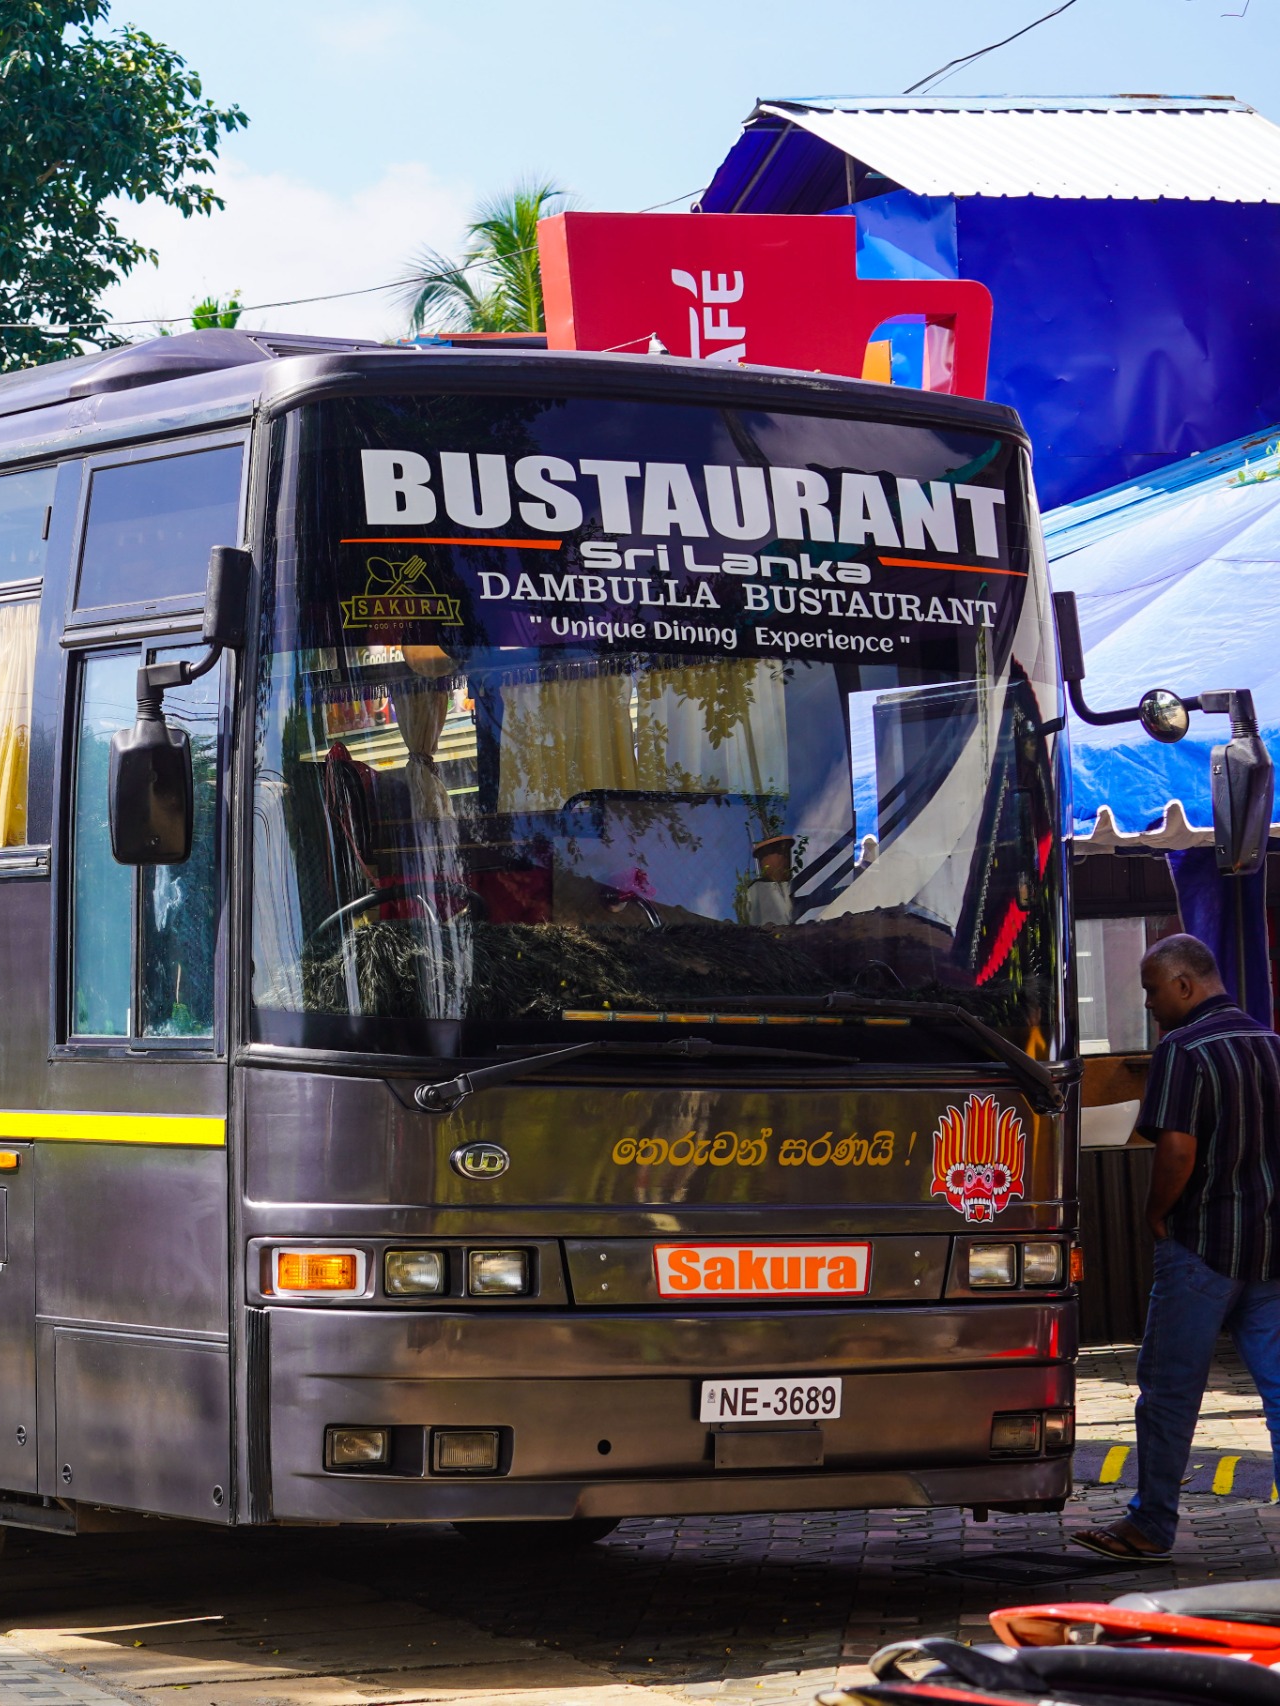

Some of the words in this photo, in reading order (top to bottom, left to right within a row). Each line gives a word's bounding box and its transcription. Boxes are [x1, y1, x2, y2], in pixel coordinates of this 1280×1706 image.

[361, 449, 1005, 560] BUSTAURANT
[581, 541, 669, 574] Sri
[684, 550, 872, 585] Lanka
[358, 600, 447, 615] SAKURA
[478, 572, 720, 610] DAMBULLA
[742, 583, 997, 628] BUSTAURANT
[551, 616, 646, 643] Unique
[655, 620, 737, 650] Dining
[755, 626, 893, 654] Experience
[465, 1152, 504, 1172] UD
[667, 1249, 858, 1291] Sakura
[719, 1385, 837, 1416] NE-3689
